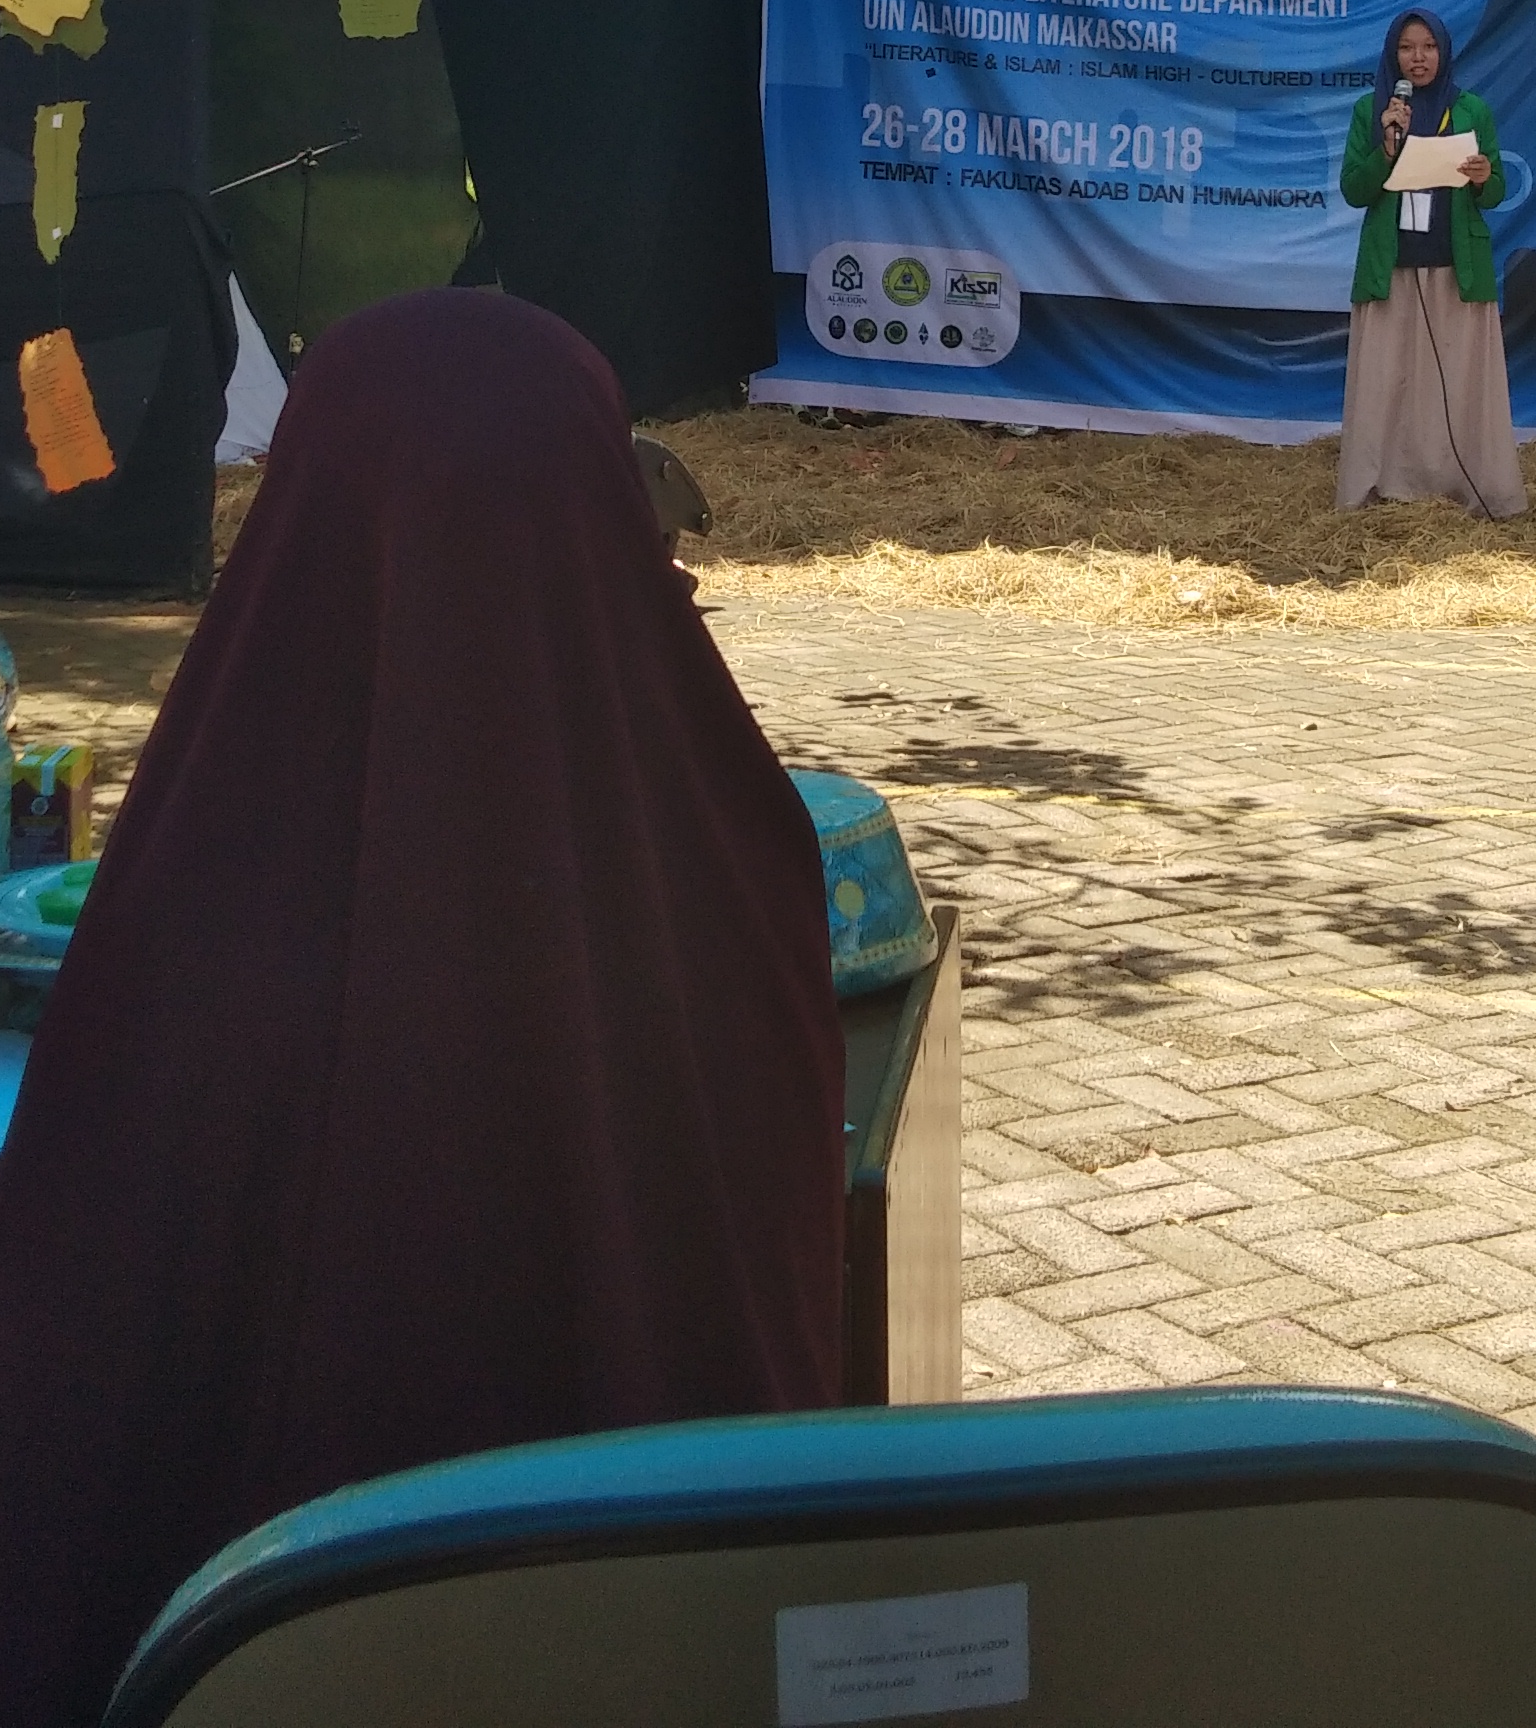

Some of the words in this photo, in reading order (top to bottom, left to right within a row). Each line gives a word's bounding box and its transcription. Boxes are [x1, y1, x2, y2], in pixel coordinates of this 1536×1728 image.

[911, 0, 1031, 45] ALAUDDIN
[1036, 13, 1178, 54] MAKASSAR
[984, 53, 997, 69] &
[1005, 56, 1061, 75] ISLAM
[1081, 61, 1138, 80] ISLAM
[1144, 64, 1191, 83] HIGH
[1211, 68, 1313, 87] CULTURED
[1321, 72, 1376, 87] LITER
[861, 103, 967, 154] 26-28
[977, 111, 1097, 166] MARCH
[1109, 124, 1203, 173] 2018
[859, 160, 939, 186] TEMPAT
[961, 168, 1062, 197] FAKULTAS
[1068, 180, 1129, 201] ADAB
[1138, 182, 1184, 204] DAN
[1192, 186, 1327, 210] HUMANIORA
